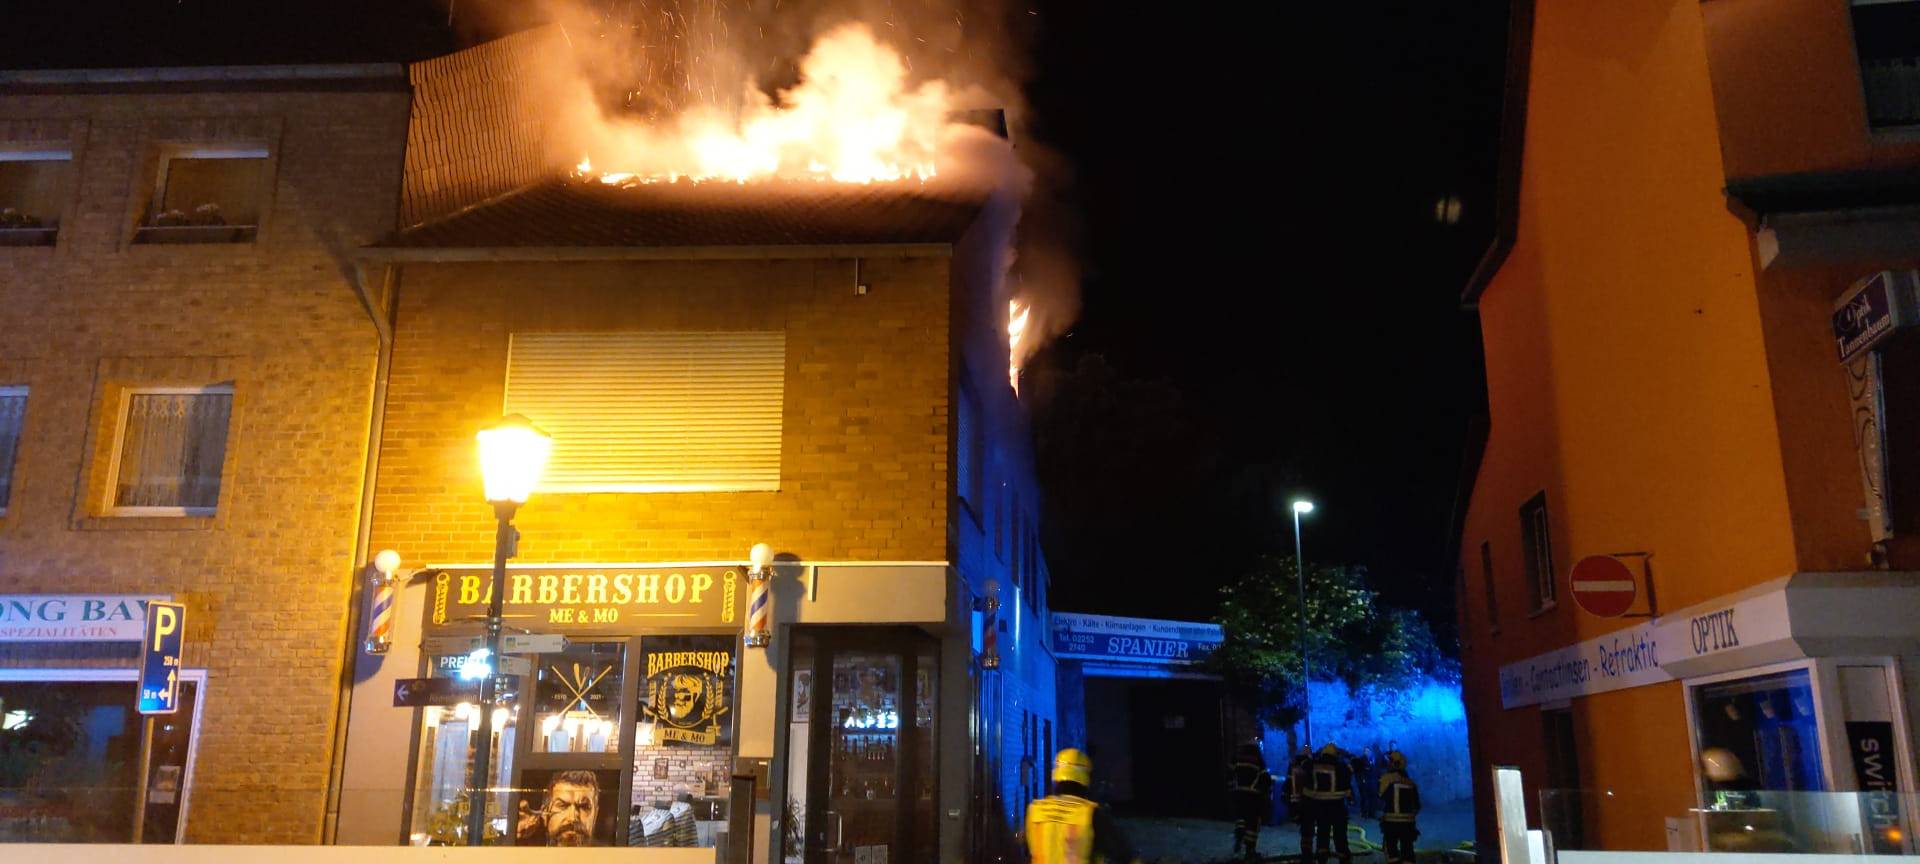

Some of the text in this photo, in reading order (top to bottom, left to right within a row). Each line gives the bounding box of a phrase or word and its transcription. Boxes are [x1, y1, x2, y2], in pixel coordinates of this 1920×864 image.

[0, 600, 66, 621] NG
[549, 607, 618, 624] ME & MO
[154, 606, 177, 652] P
[1690, 609, 1739, 655] OPTIK
[1107, 636, 1188, 657] SPANIER
[646, 651, 729, 679] BARBERSHOP
[664, 729, 706, 743] ME & MO
